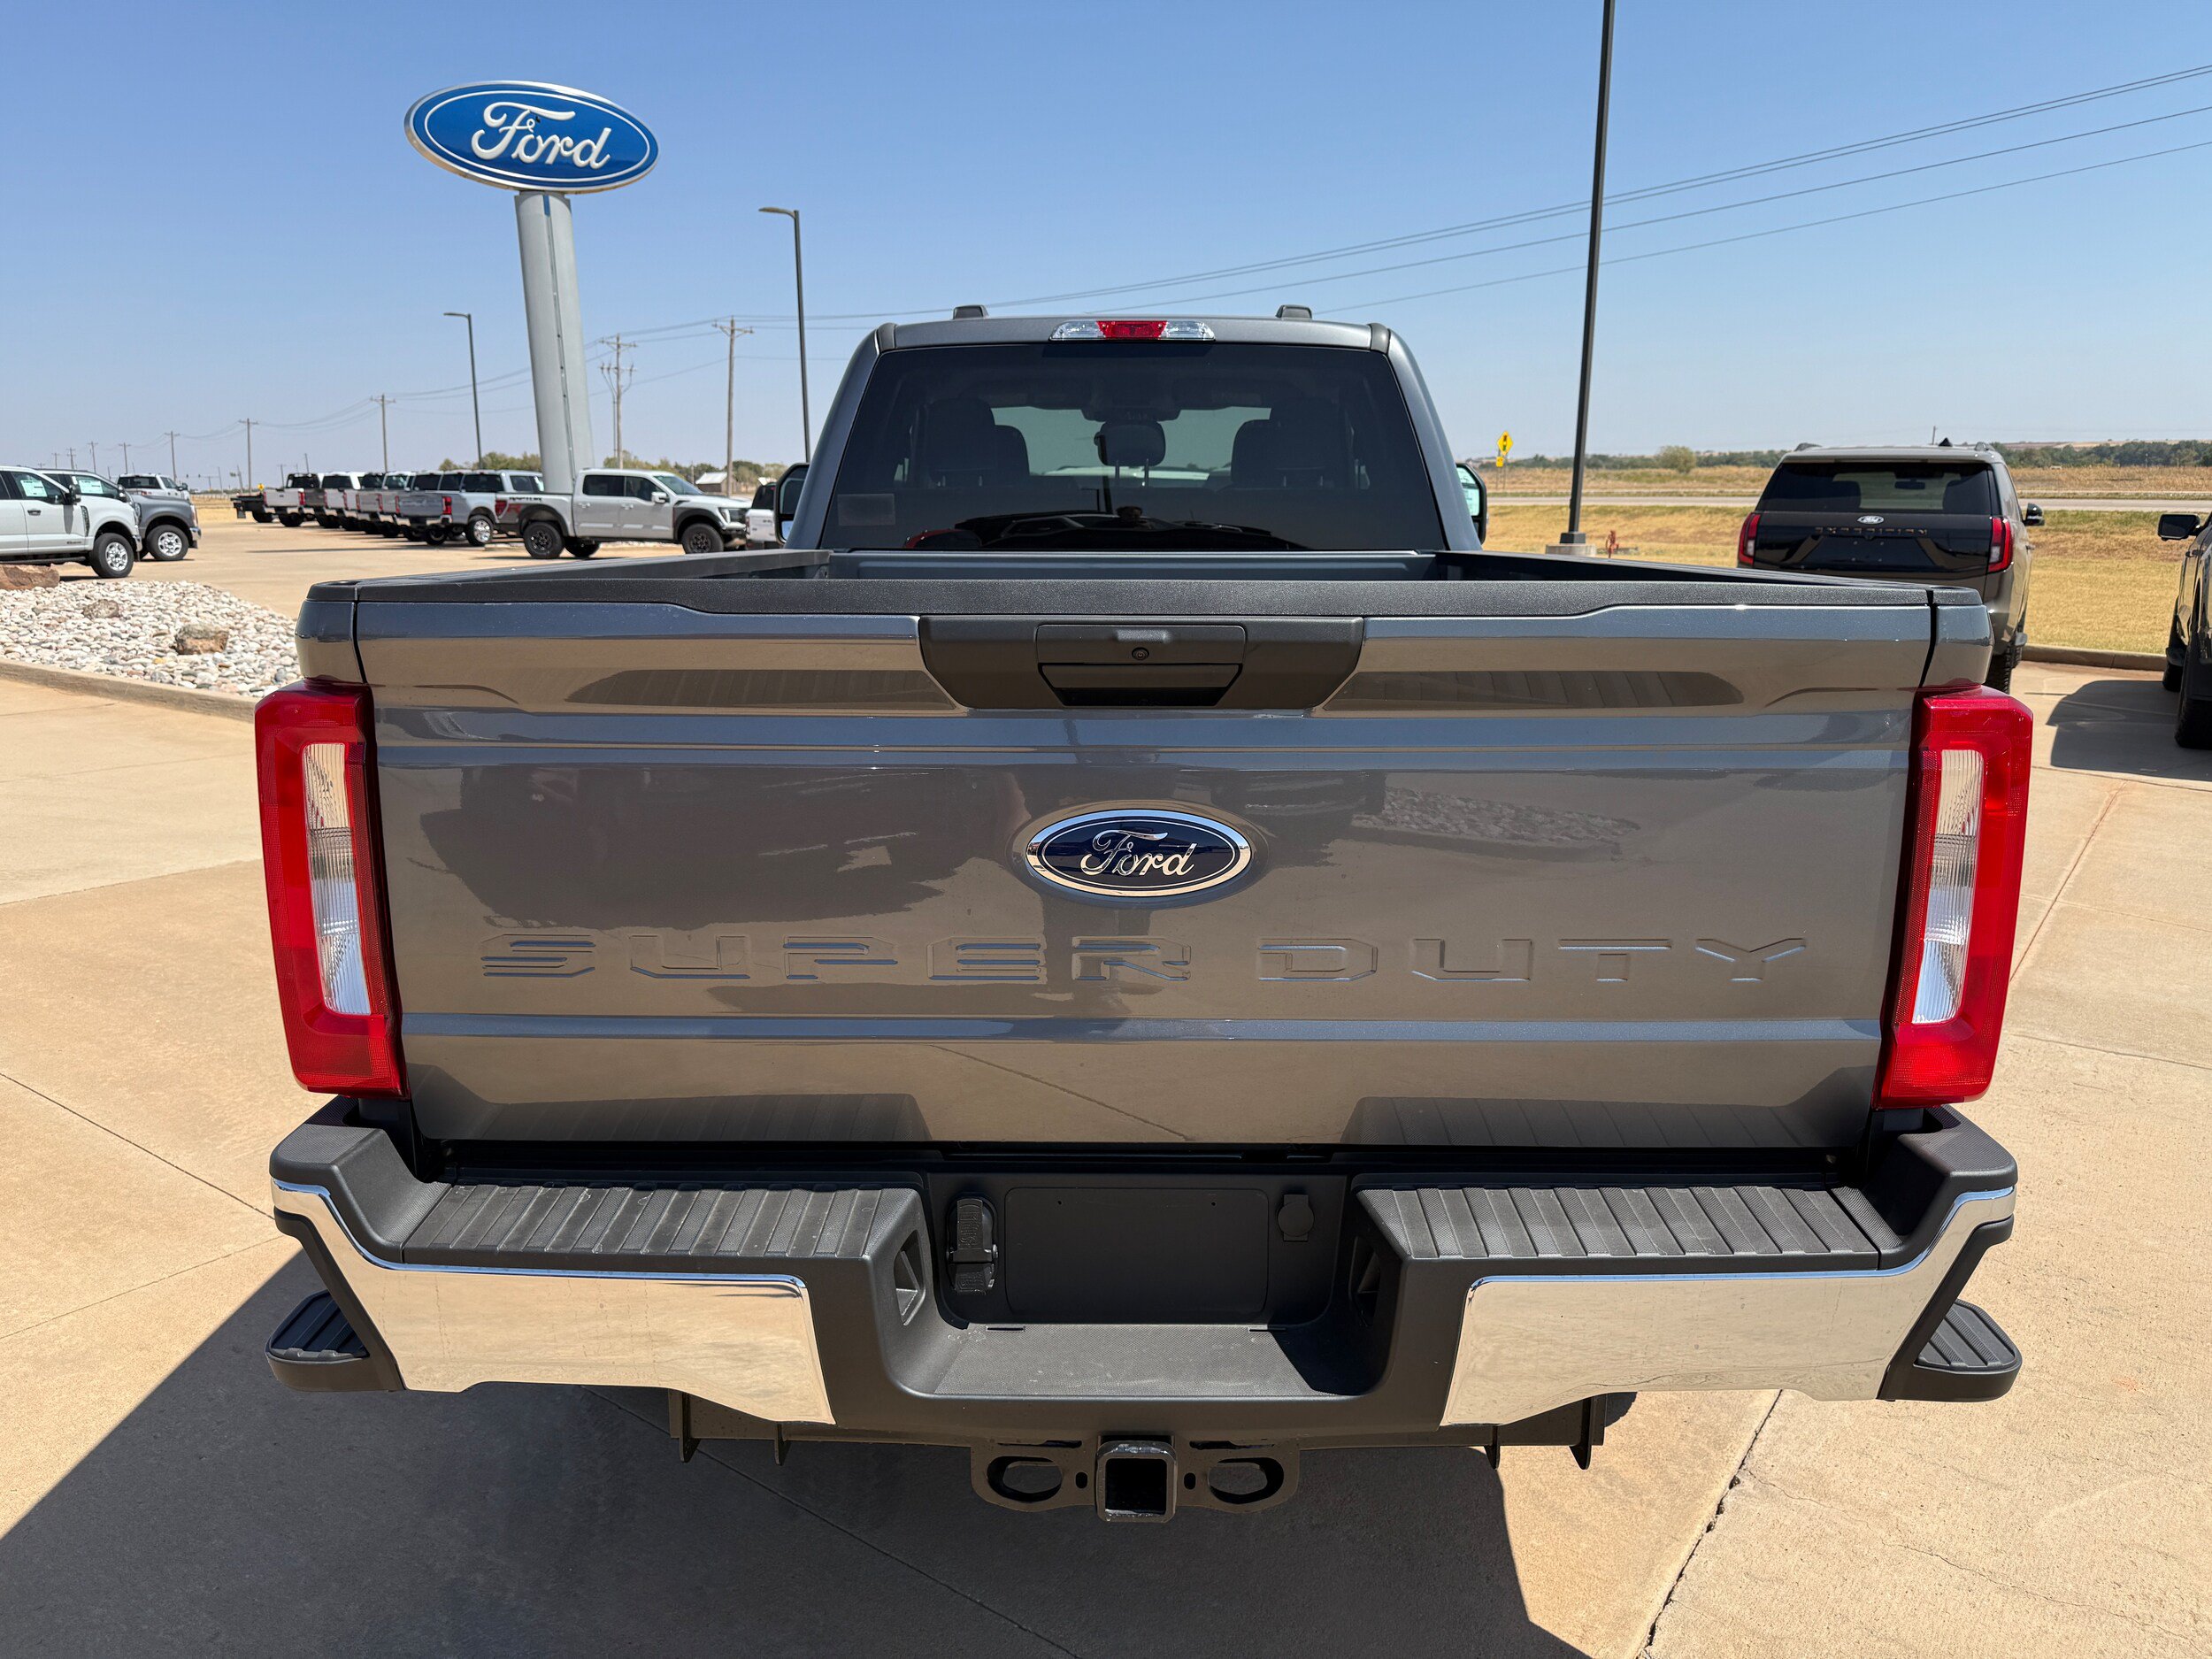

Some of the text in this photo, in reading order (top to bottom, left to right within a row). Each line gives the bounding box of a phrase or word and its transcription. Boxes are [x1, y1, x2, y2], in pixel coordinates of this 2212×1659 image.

[471, 101, 612, 170] Ford
[1079, 829, 1198, 877] Ford
[480, 933, 1808, 982] SUPER DUTY
